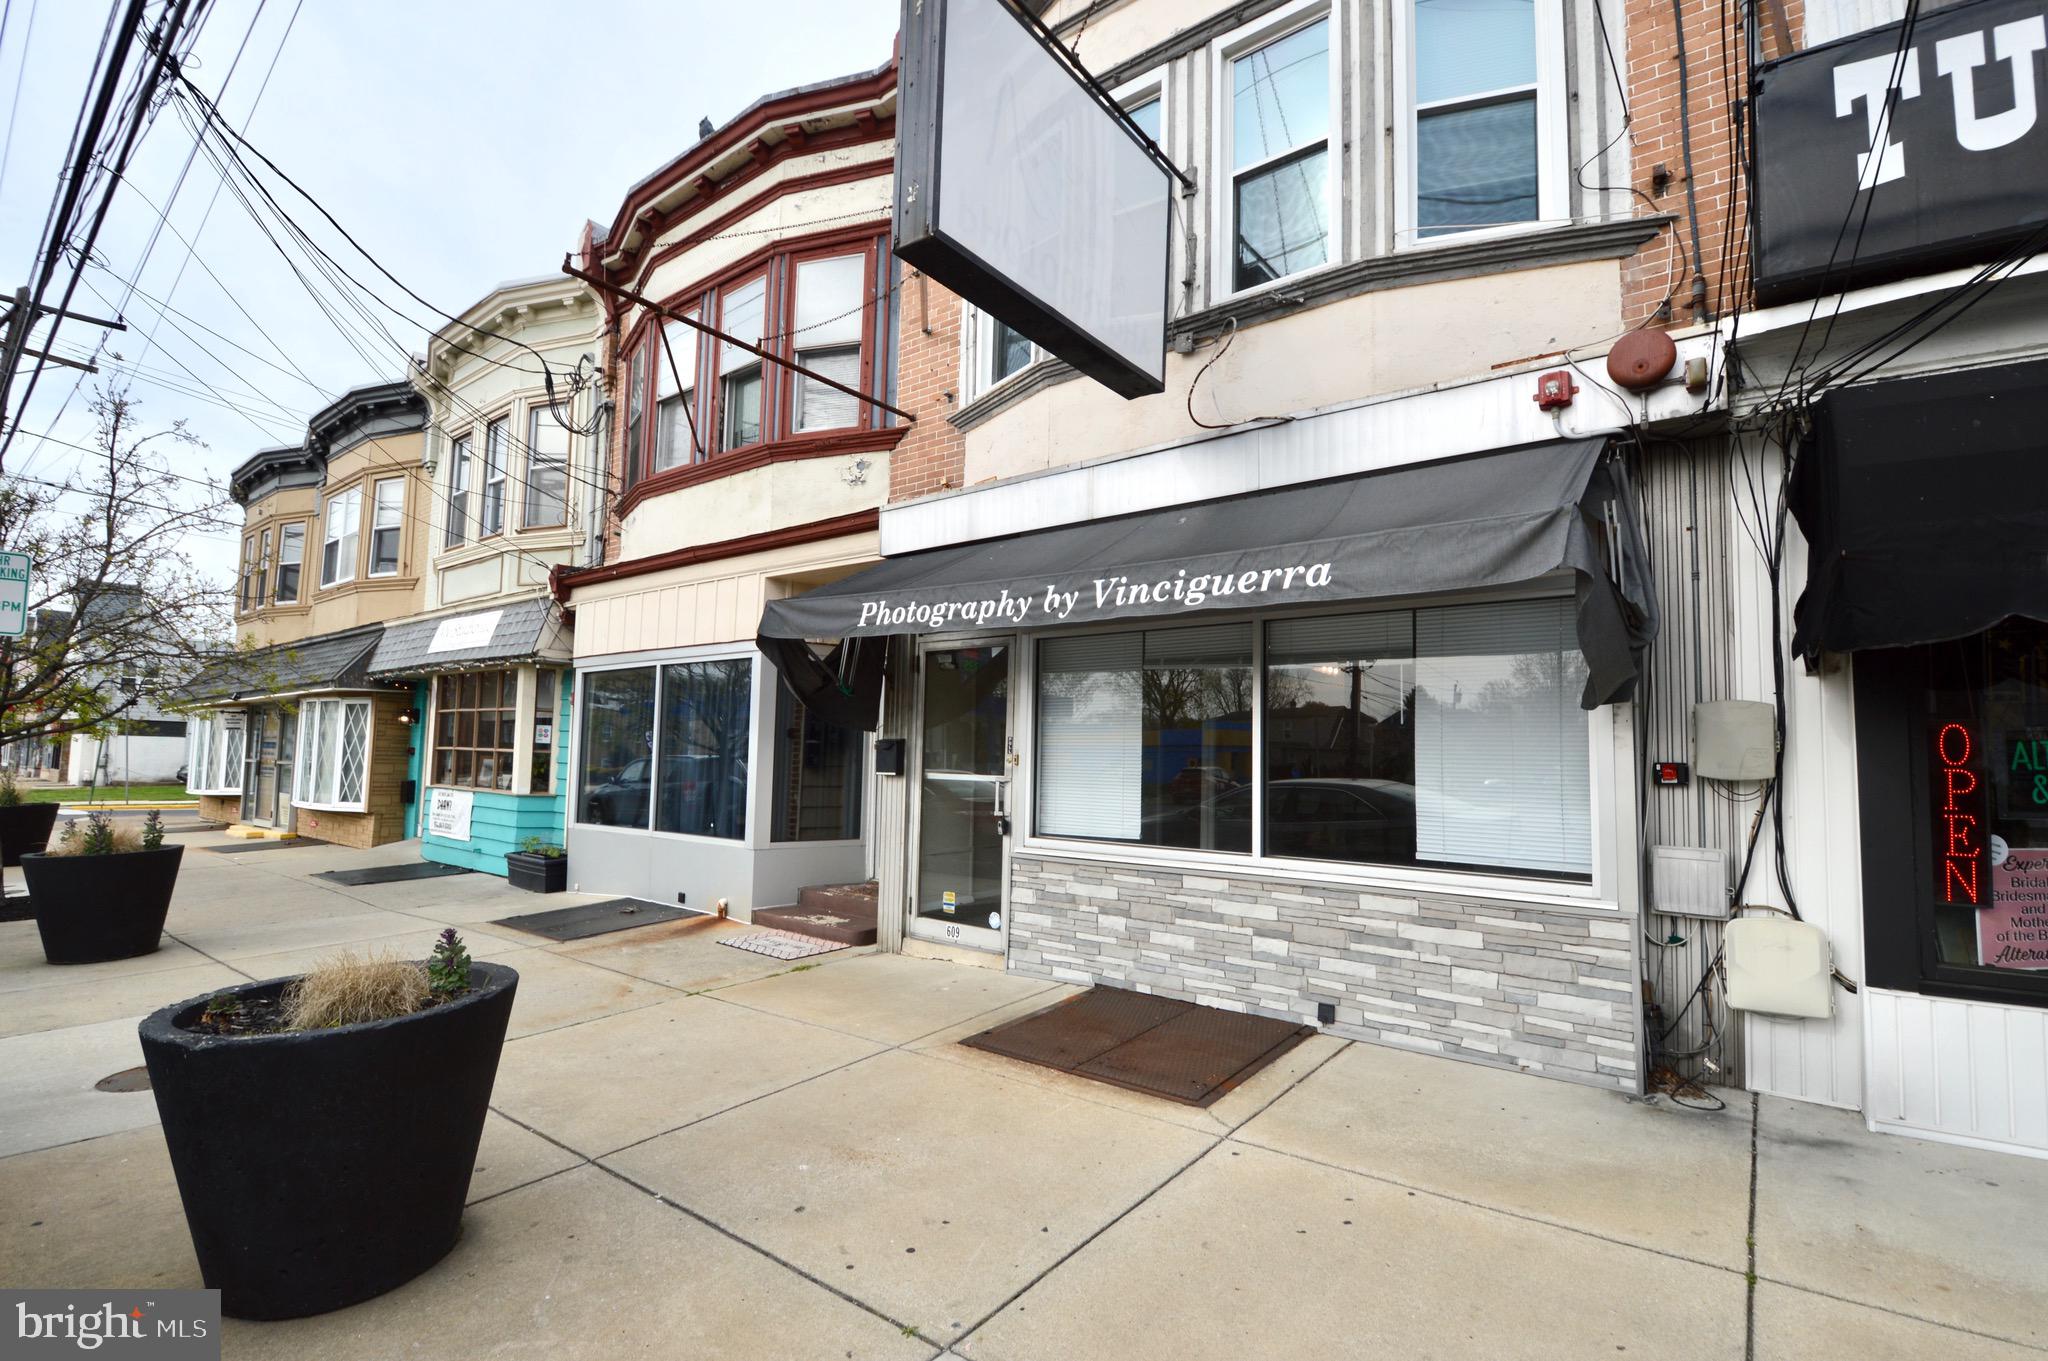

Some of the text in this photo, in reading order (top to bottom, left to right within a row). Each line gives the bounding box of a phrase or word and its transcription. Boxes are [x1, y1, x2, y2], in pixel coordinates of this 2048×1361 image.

[1833, 14, 2047, 191] TU
[857, 562, 1332, 628] Photography by Vinciguerra
[2032, 773, 2048, 805] &
[1940, 723, 1981, 904] OPEN
[2021, 904, 2046, 915] and
[946, 925, 960, 938] 609
[1996, 930, 2011, 942] of
[2013, 930, 2035, 942] the
